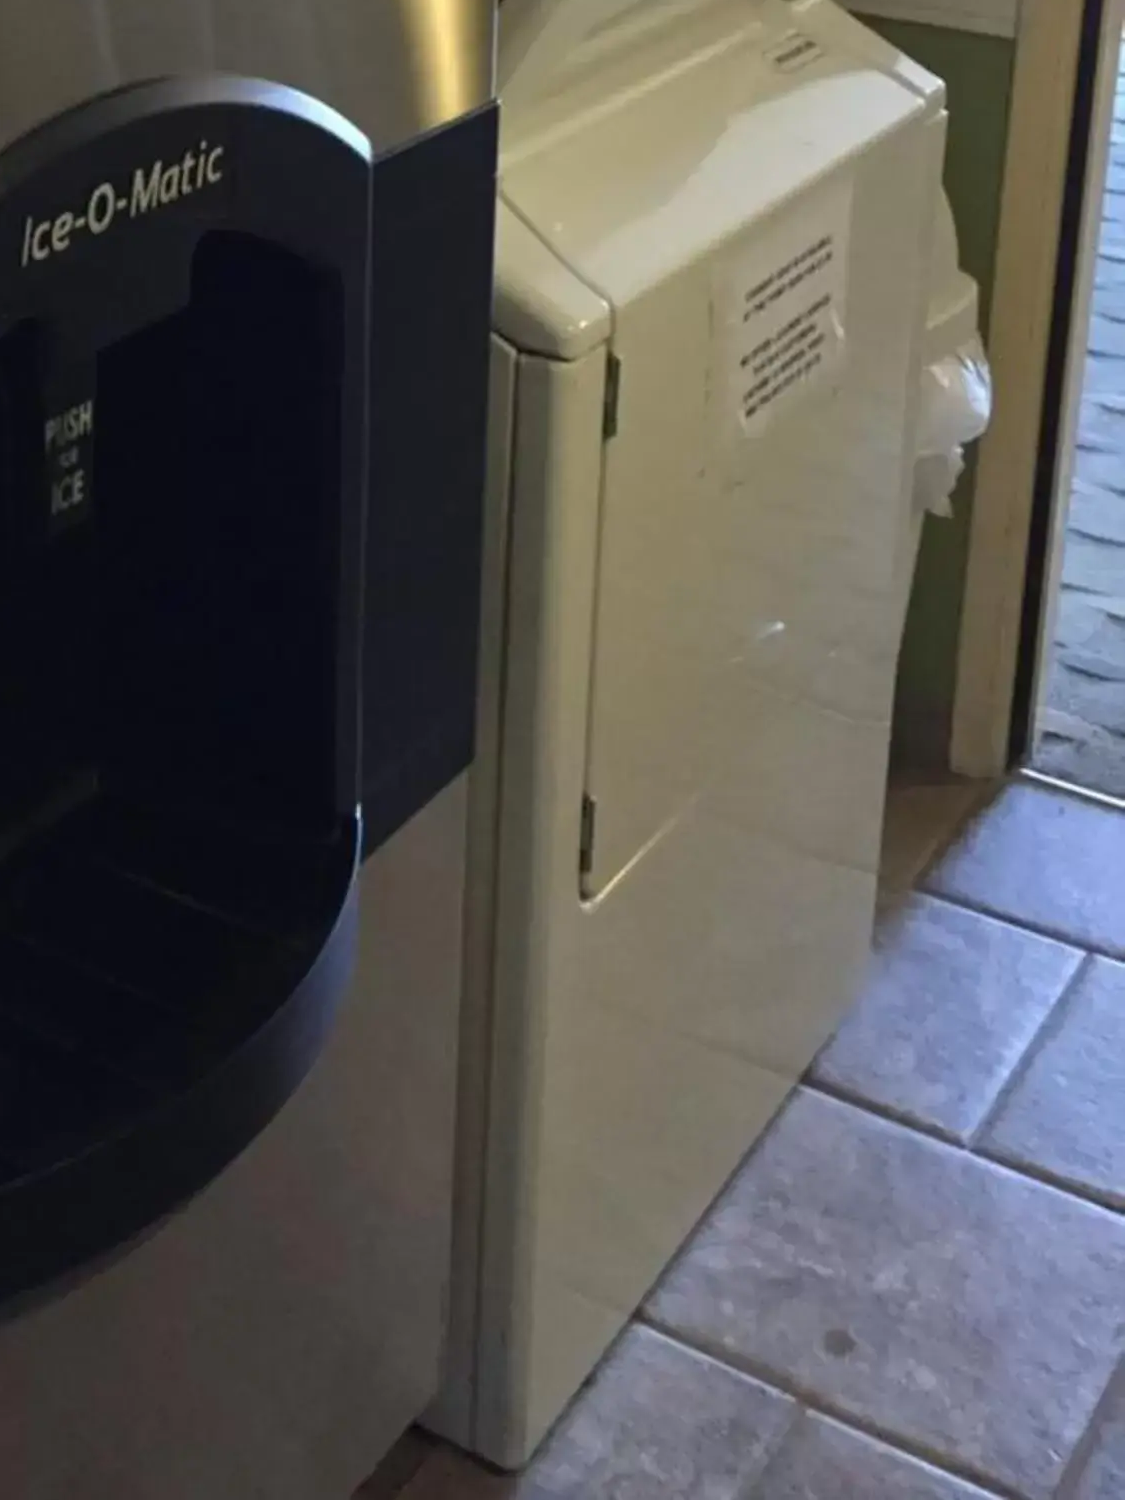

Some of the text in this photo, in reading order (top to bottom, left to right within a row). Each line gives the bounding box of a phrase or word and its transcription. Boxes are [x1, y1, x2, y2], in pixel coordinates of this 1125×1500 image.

[21, 138, 225, 268] Ice-O-Matic
[44, 399, 93, 455] PUSH
[50, 468, 85, 516] ICE
